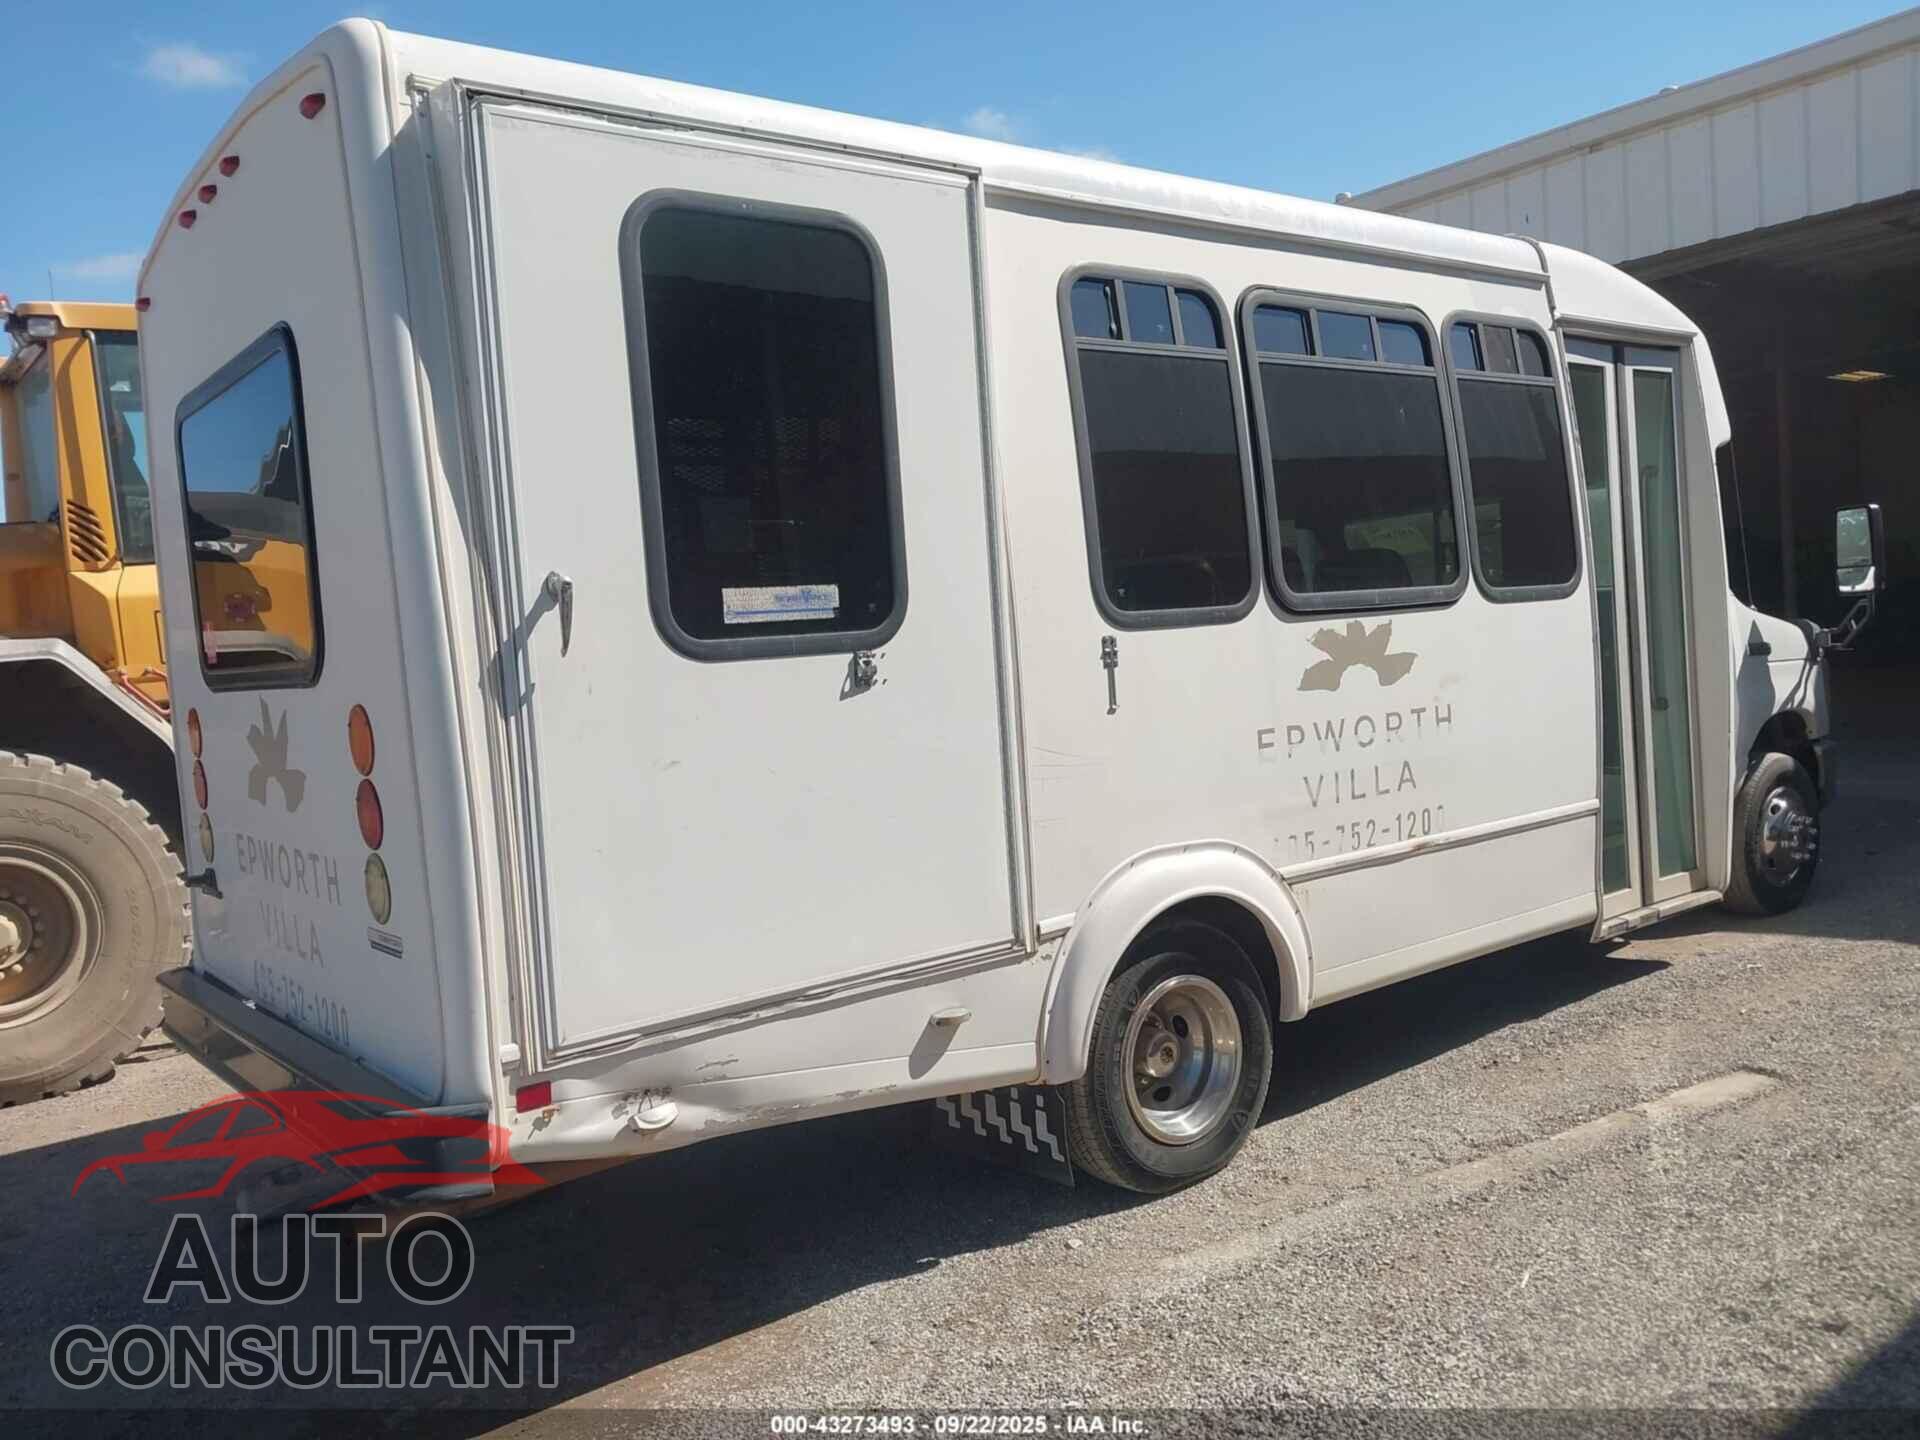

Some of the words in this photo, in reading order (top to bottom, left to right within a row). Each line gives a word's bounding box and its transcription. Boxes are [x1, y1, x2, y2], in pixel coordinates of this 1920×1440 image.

[1257, 703, 1452, 758] EPWORTH
[1303, 760, 1417, 808] VILLA
[236, 832, 341, 907] EPWORTH
[258, 899, 325, 968] VILLA
